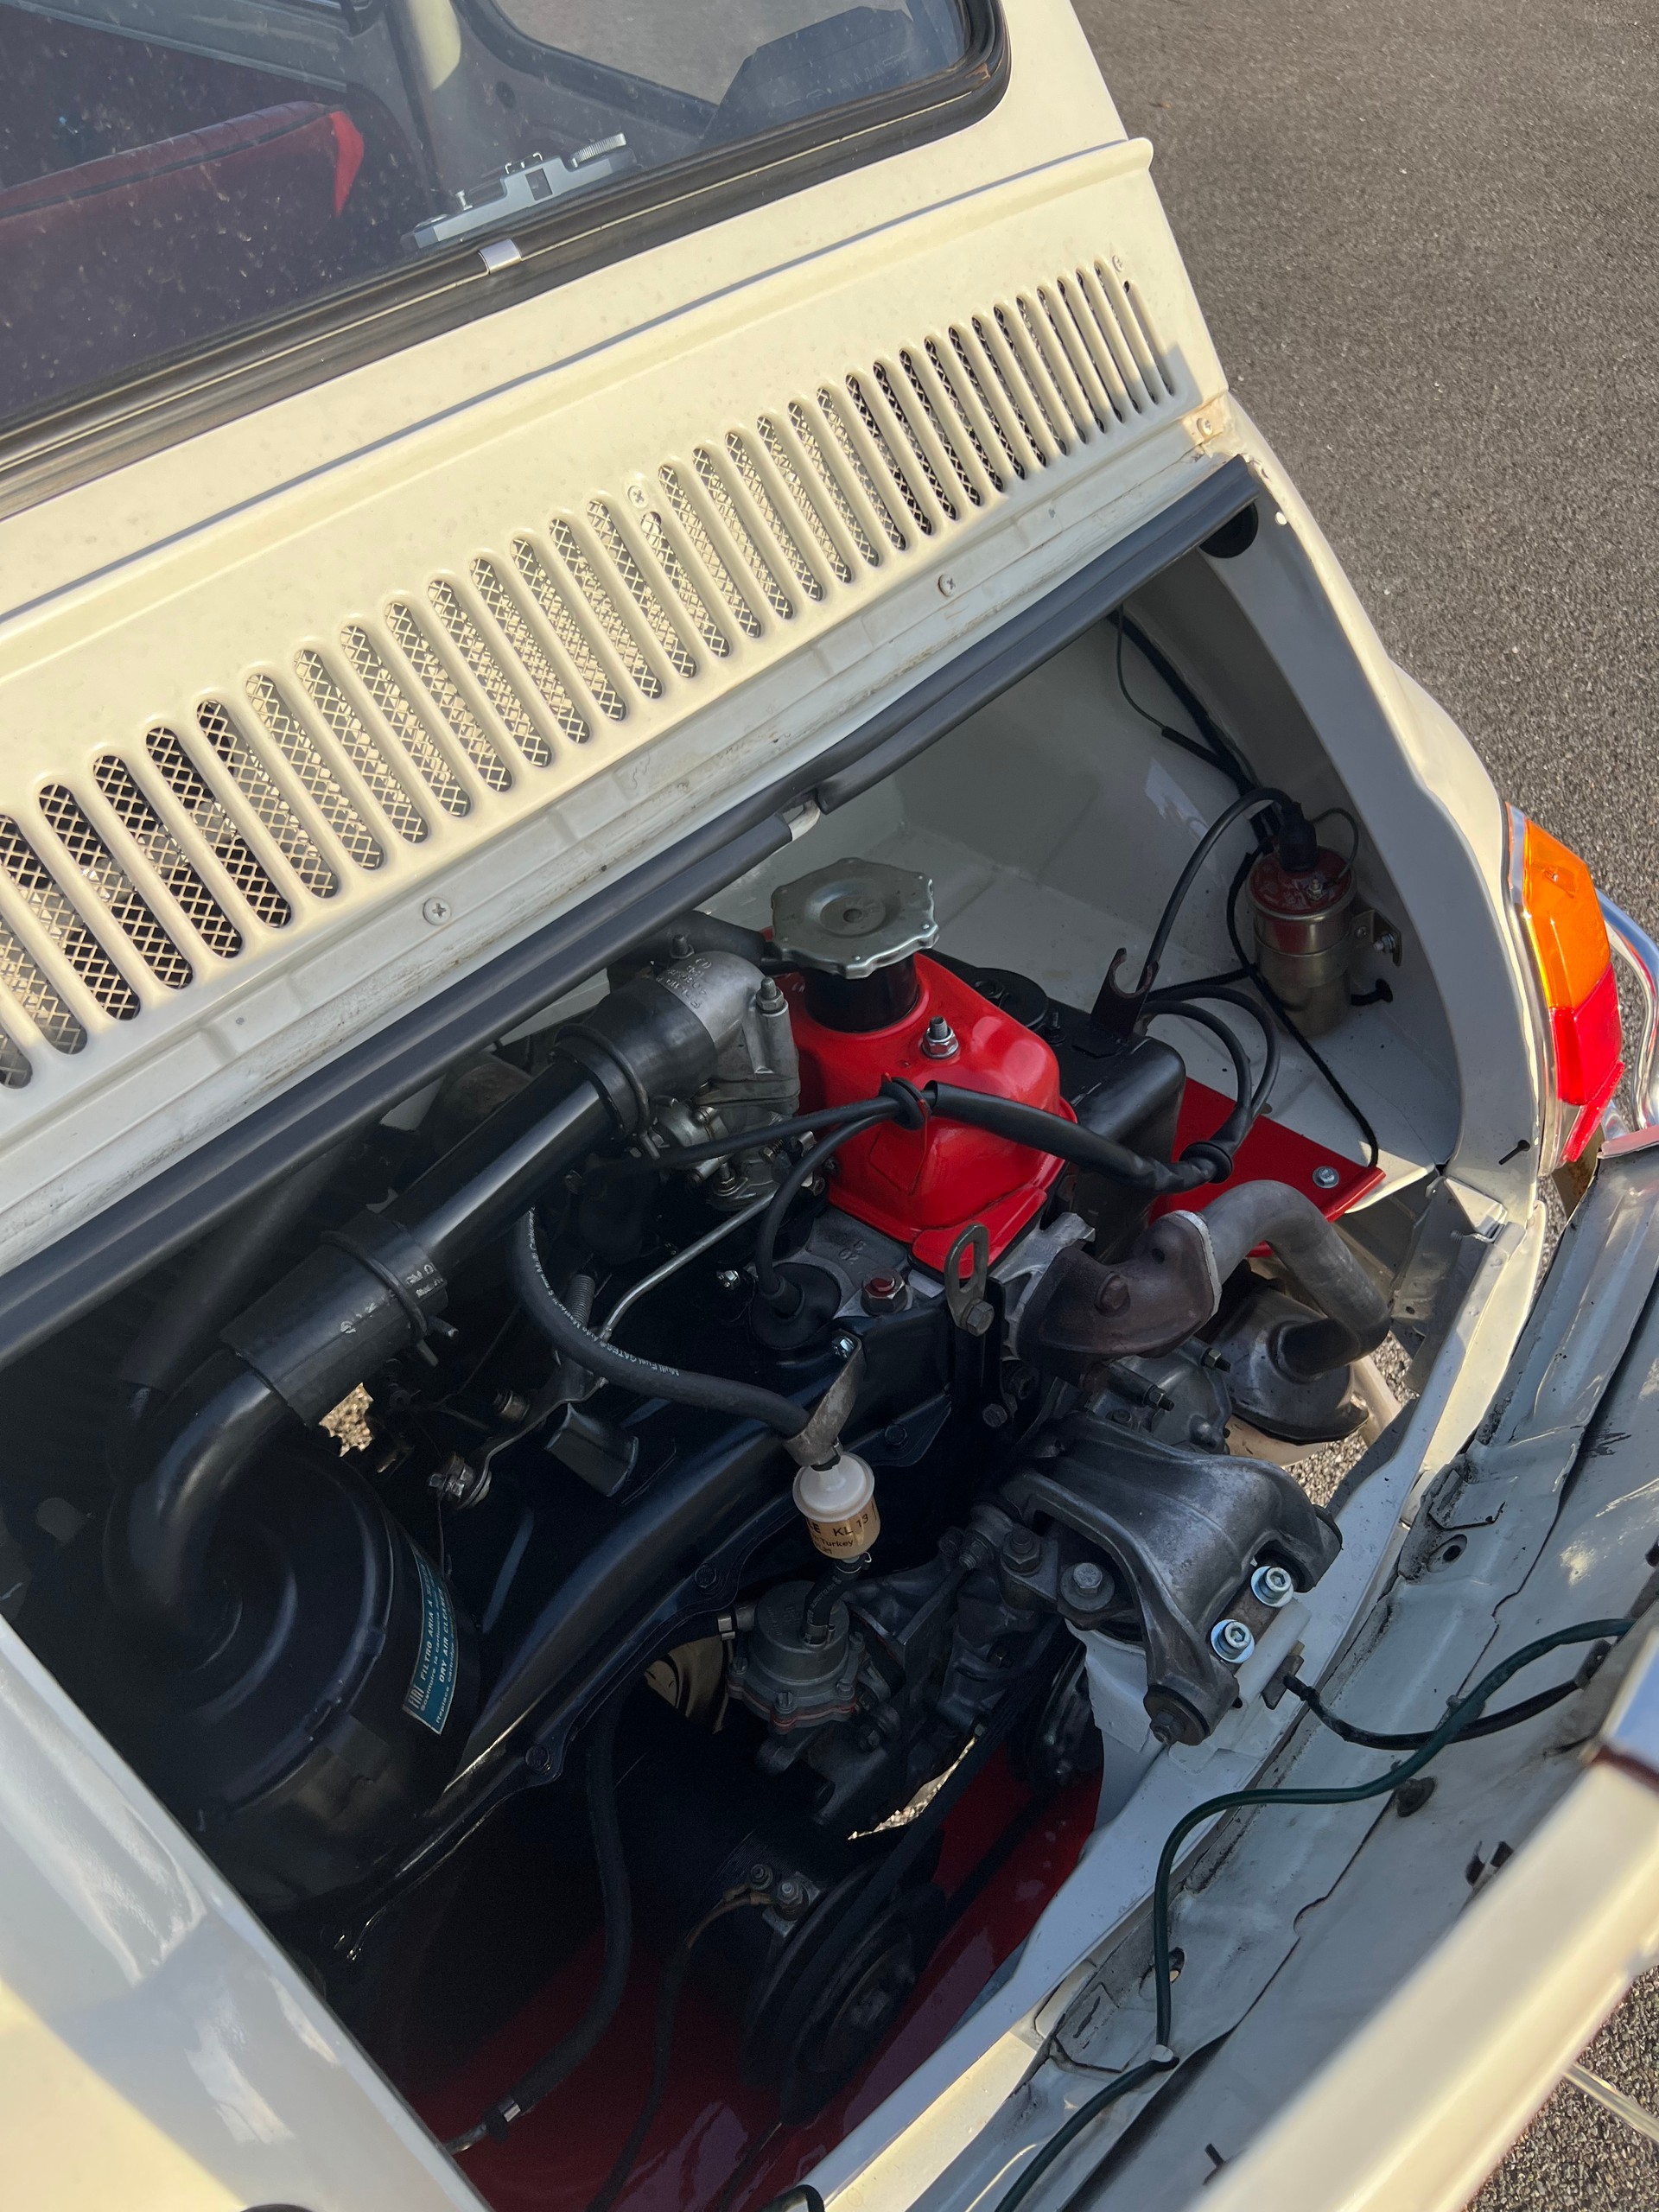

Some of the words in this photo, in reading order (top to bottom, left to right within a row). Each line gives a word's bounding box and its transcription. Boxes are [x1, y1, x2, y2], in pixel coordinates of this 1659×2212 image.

[820, 1537, 854, 1547] Turkey
[833, 1527, 854, 1536] KL
[420, 1640, 433, 1681] FILTRO
[438, 1659, 448, 1683] DRY
[408, 1685, 424, 1709] FIAT
[435, 1686, 450, 1724] Replace
